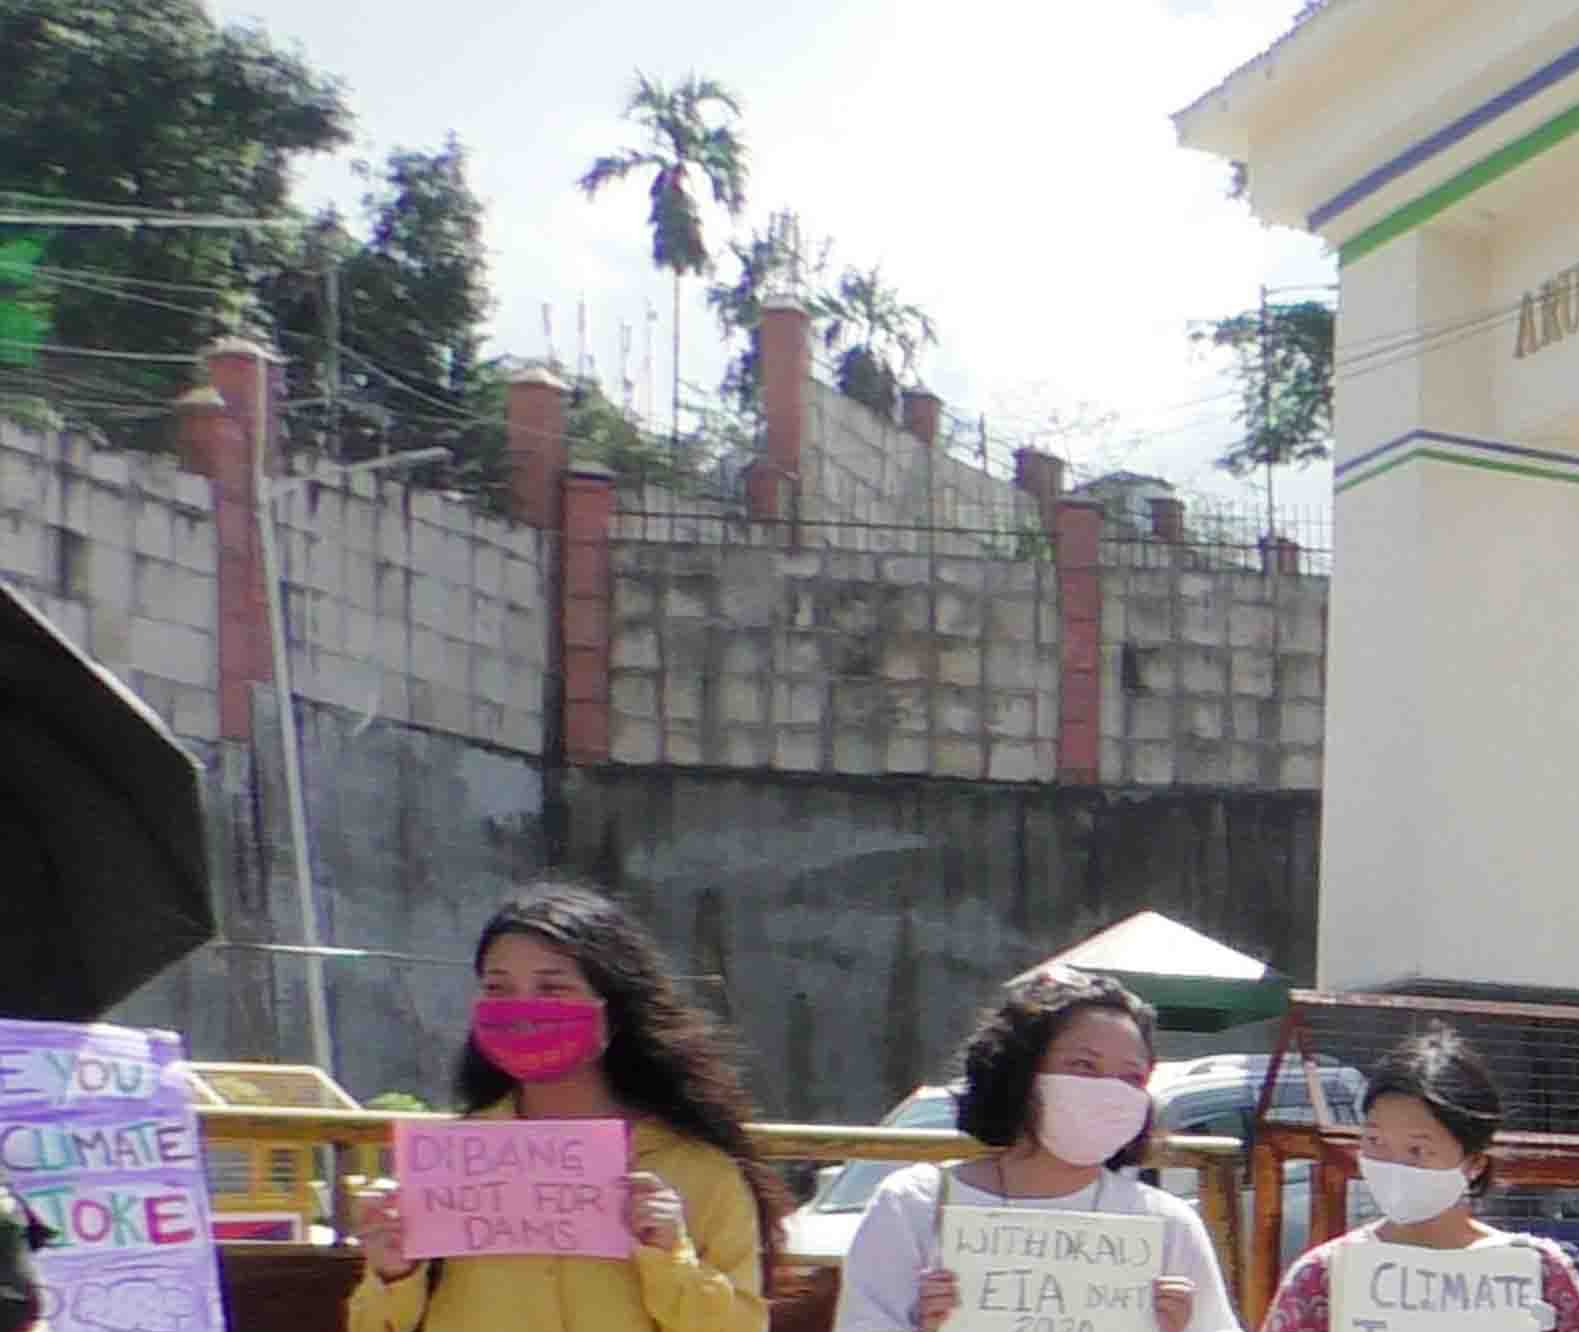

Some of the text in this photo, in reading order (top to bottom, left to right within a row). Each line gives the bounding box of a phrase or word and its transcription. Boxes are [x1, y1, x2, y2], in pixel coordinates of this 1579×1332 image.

[45, 1048, 143, 1105] YOU
[2, 1119, 195, 1171] CLIMATE
[410, 1134, 586, 1176] DIBANG
[25, 1186, 196, 1247] JOKE
[423, 1181, 605, 1214] NOT FOR
[464, 1216, 577, 1250] DAMS
[954, 1225, 1152, 1267] WITHDRAW
[979, 1269, 1065, 1314] EIA
[1370, 1262, 1534, 1312] CLIMATE
